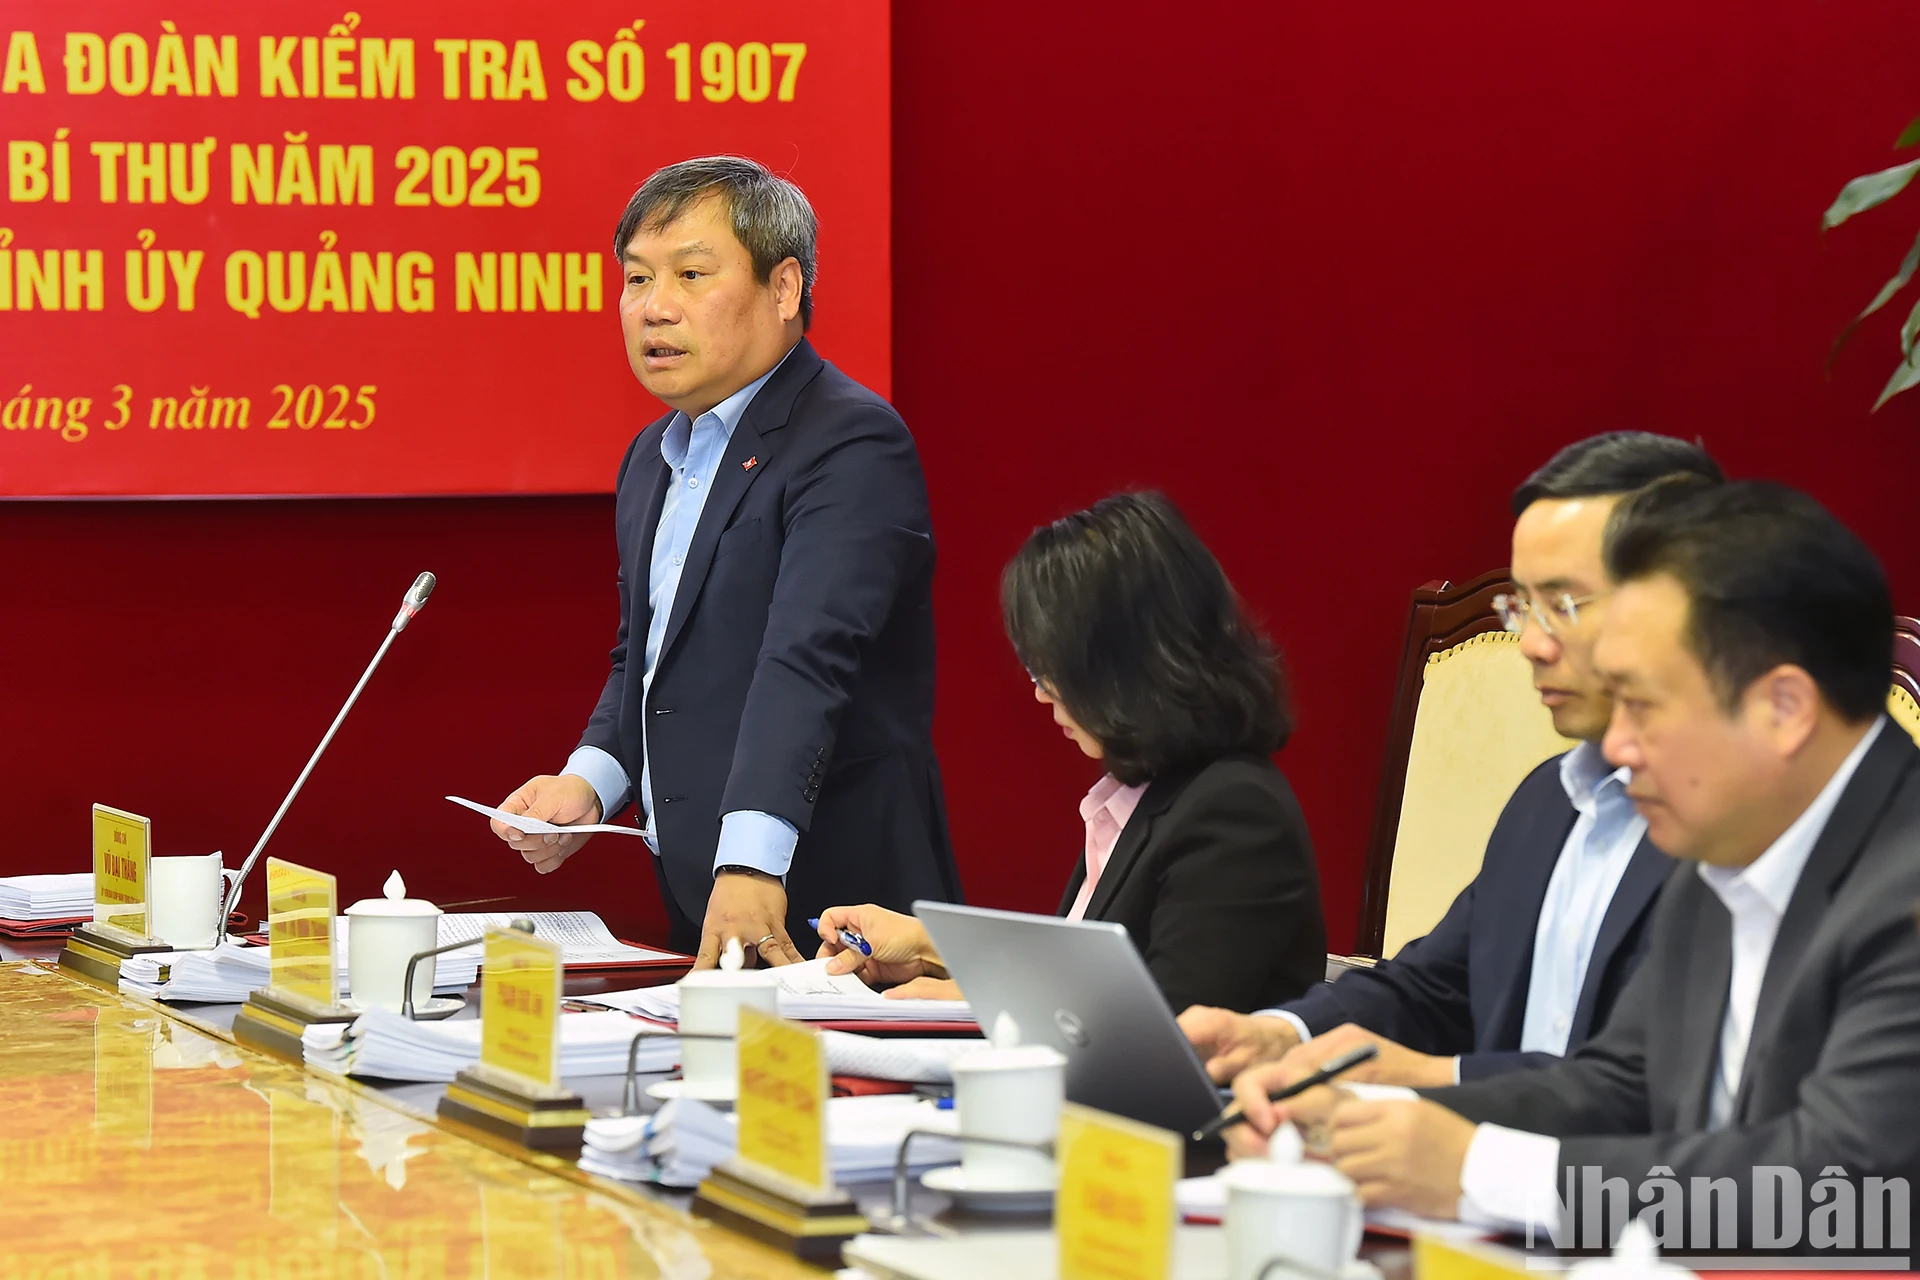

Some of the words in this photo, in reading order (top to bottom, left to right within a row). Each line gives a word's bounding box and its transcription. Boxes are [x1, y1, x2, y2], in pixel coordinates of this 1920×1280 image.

[2, 30, 46, 94] A
[63, 21, 239, 97] ĐOÀN
[260, 12, 415, 100] KIỂM
[434, 38, 548, 101] TRA
[567, 19, 645, 103] SỐ
[665, 41, 807, 103] 1907
[8, 127, 71, 203] BÍ
[90, 136, 217, 205] THƯ
[231, 131, 374, 206] NĂM
[395, 145, 541, 208] 2025
[126, 228, 204, 312] ỦY
[226, 230, 435, 319] QUẢNG
[456, 251, 603, 313] NINH
[0, 383, 93, 442] áng
[103, 384, 133, 430] 3
[148, 386, 251, 431] năm
[267, 384, 377, 430] 2025
